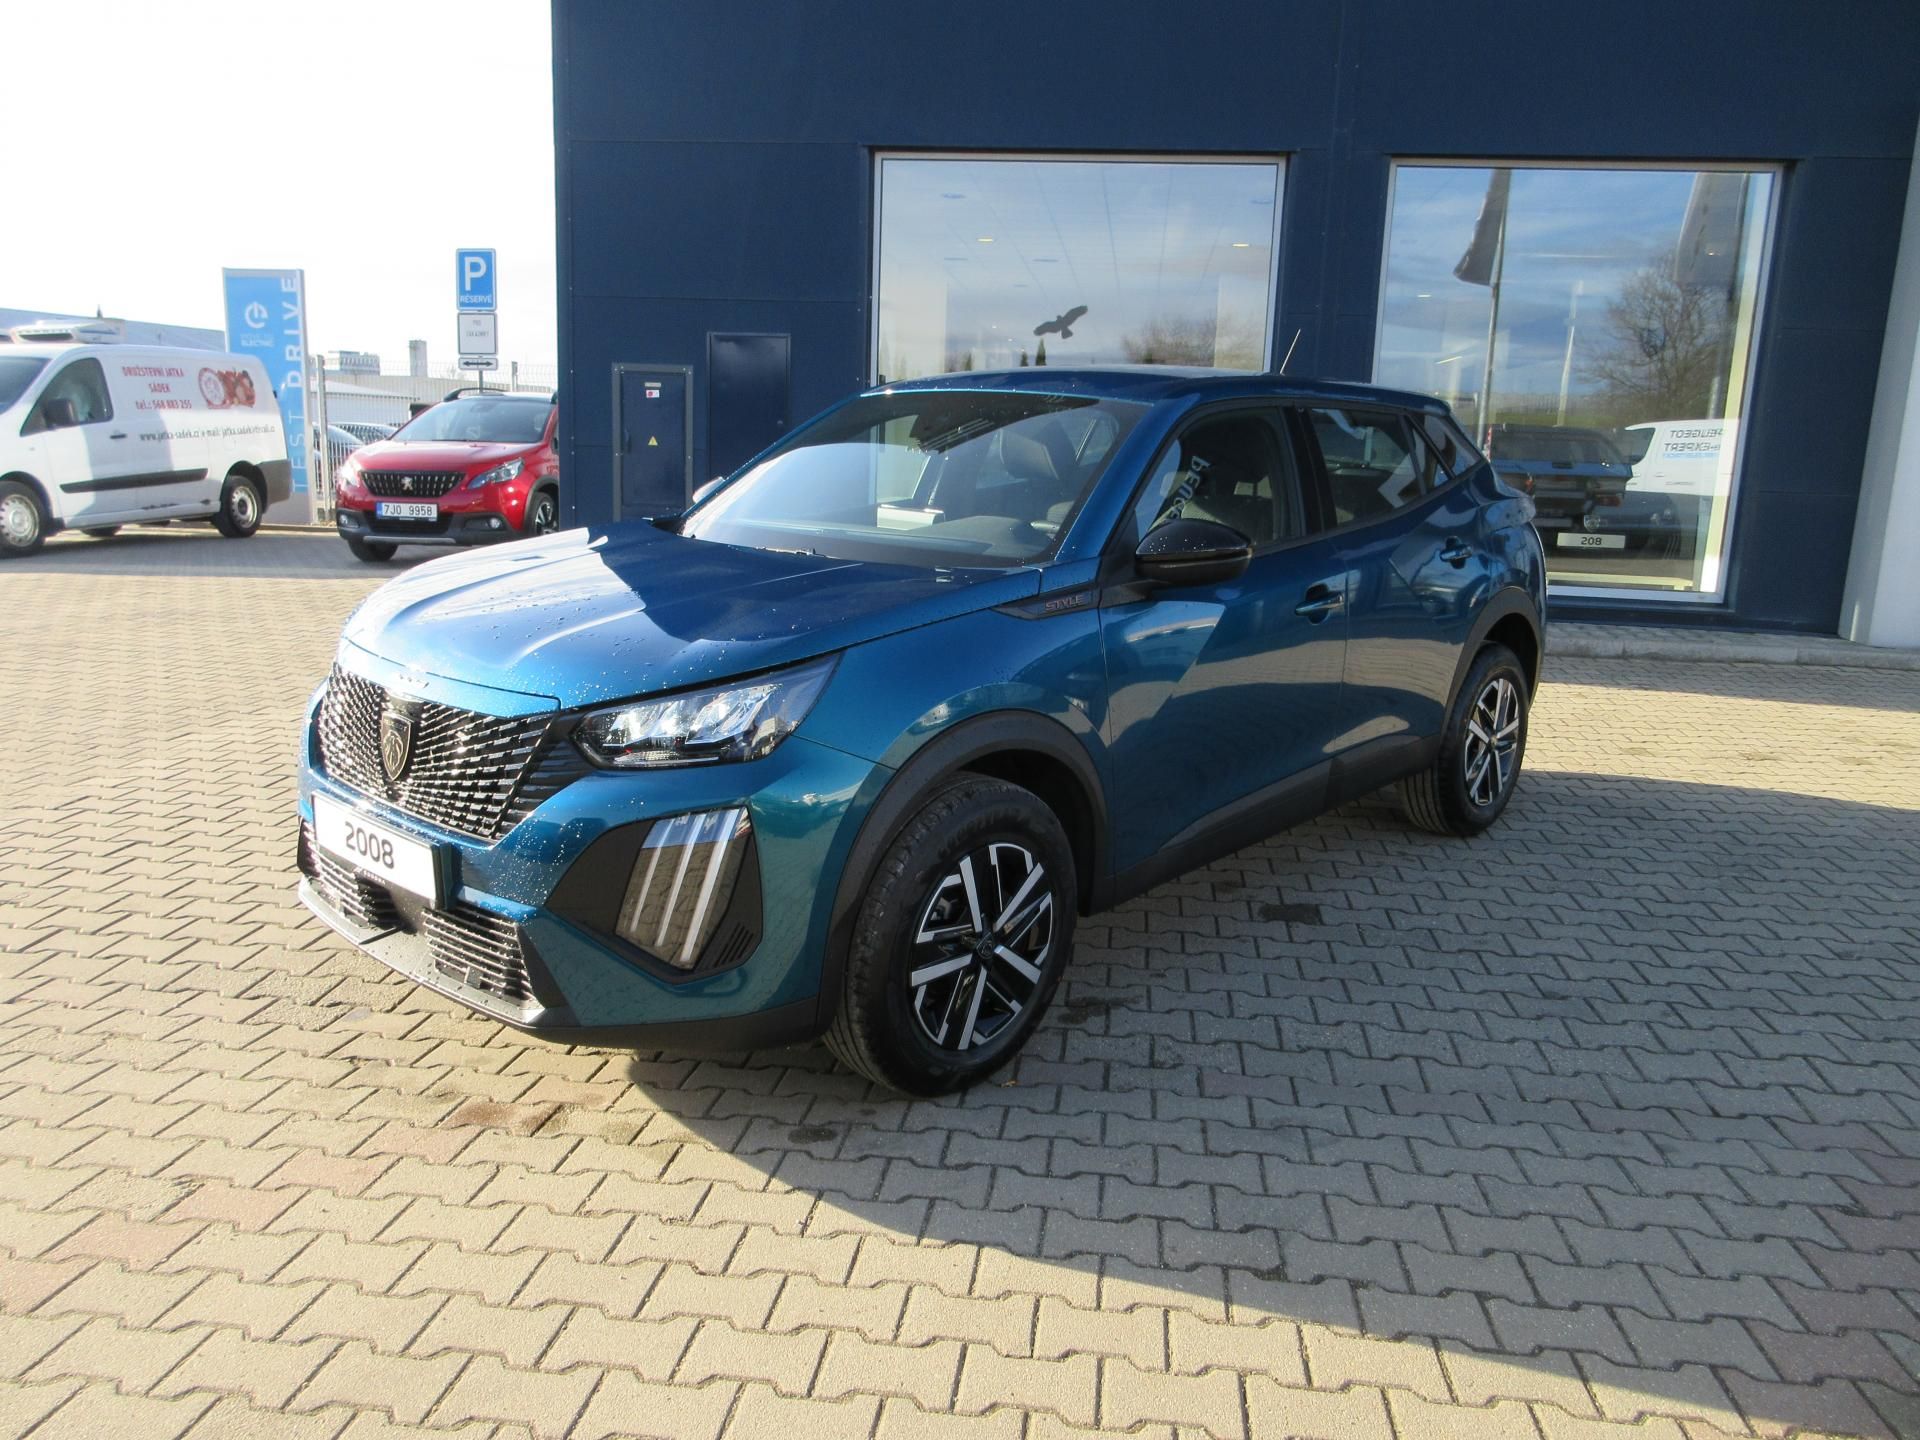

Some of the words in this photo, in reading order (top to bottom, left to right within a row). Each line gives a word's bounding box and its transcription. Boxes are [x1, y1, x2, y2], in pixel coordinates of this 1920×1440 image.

[464, 256, 487, 291] P
[281, 276, 303, 388] DRIVE
[178, 399, 192, 409] 255
[288, 409, 309, 493] TEST
[384, 504, 402, 515] 7J0
[408, 505, 433, 516] 9958
[1581, 536, 1602, 546] 208
[1045, 594, 1085, 611] STYLE
[344, 820, 395, 869] 2008
